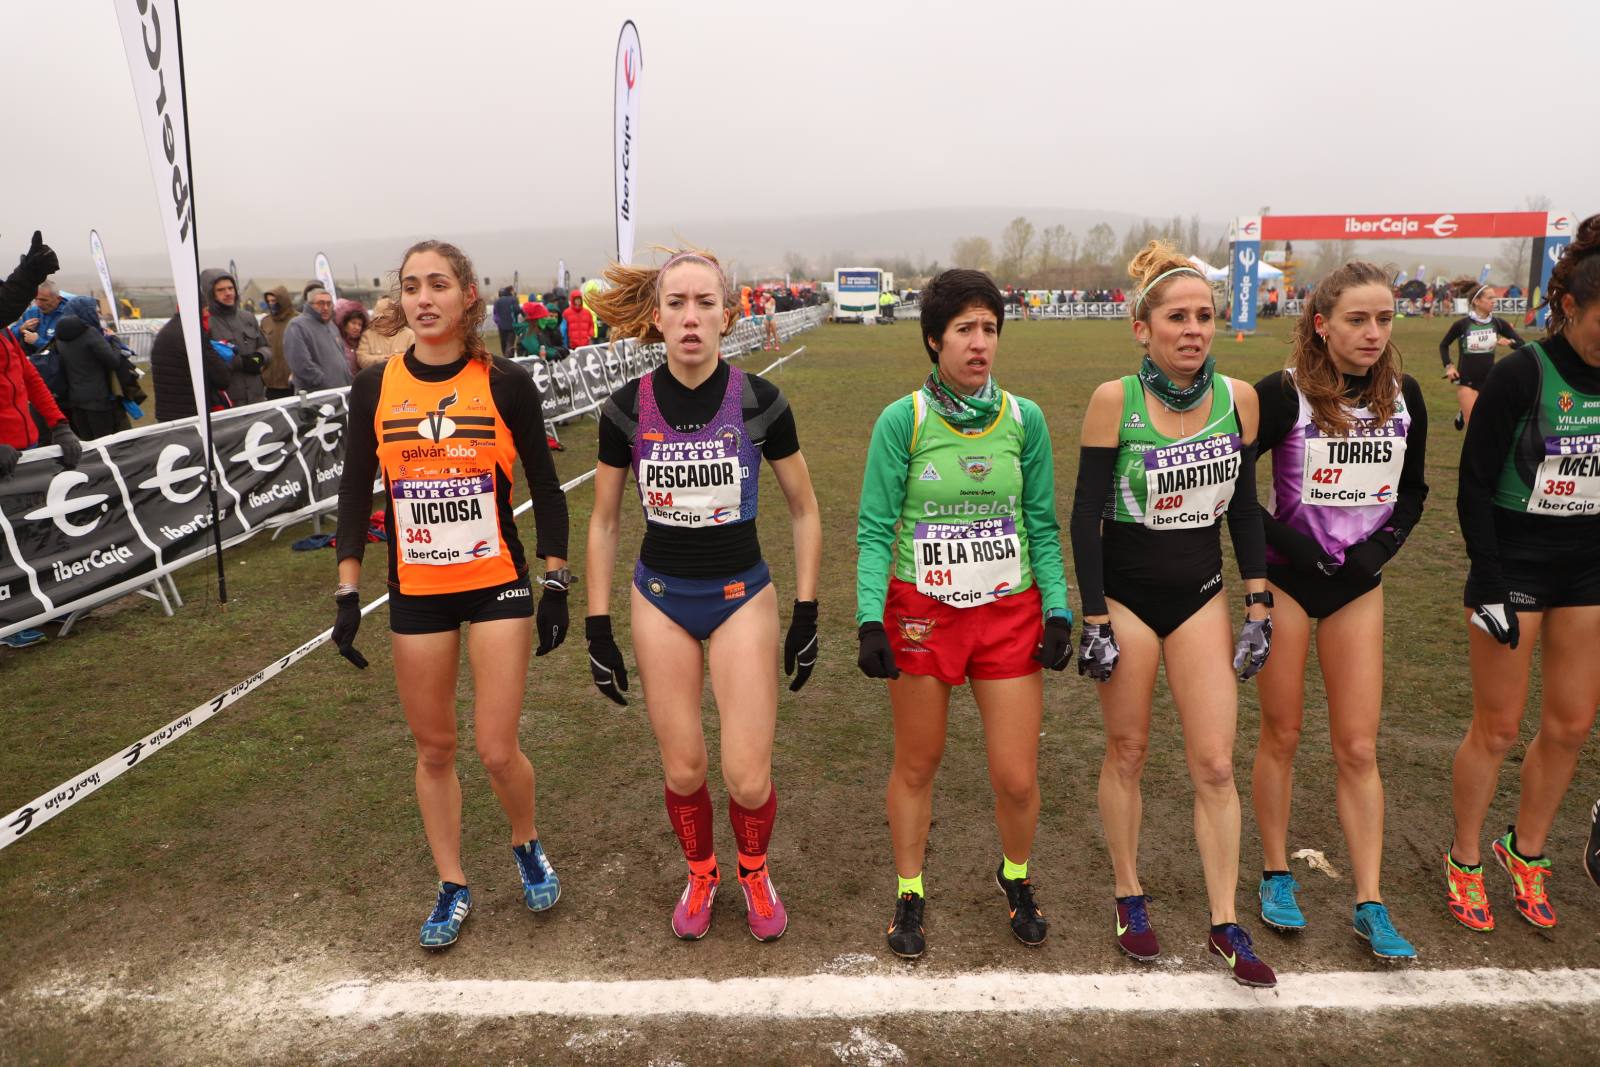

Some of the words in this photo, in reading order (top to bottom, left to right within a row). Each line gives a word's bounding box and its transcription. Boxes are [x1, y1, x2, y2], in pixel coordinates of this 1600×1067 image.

[620, 115, 632, 221] iberCaja
[1344, 216, 1419, 236] iberCaja
[650, 448, 726, 460] BURGOS
[1156, 435, 1231, 459] DIPUTACIÓN
[1157, 444, 1234, 468] BURGOS
[1327, 440, 1393, 464] TORRES
[402, 476, 482, 490] DIPUTACIÓN
[646, 461, 735, 488] PESCADOR
[1157, 456, 1238, 495] MARTINEZ
[1311, 468, 1343, 484] 427
[249, 479, 302, 509] iberCaja
[403, 484, 483, 499] BURGOS
[1310, 488, 1366, 502] iberCaja
[1543, 479, 1576, 496] 359
[647, 491, 674, 508] 354
[1154, 494, 1184, 511] 420
[1537, 498, 1595, 513] iberCaja
[410, 498, 483, 525] VICIOSA
[1152, 510, 1209, 525] iberCaja
[406, 528, 432, 544] 343
[408, 548, 460, 561] iberCaja
[922, 543, 943, 566] DE
[947, 542, 968, 565] LA
[970, 537, 1016, 563] ROSA
[52, 543, 134, 583] iberCaja
[924, 569, 953, 587] 431
[1200, 574, 1222, 593] NIKE
